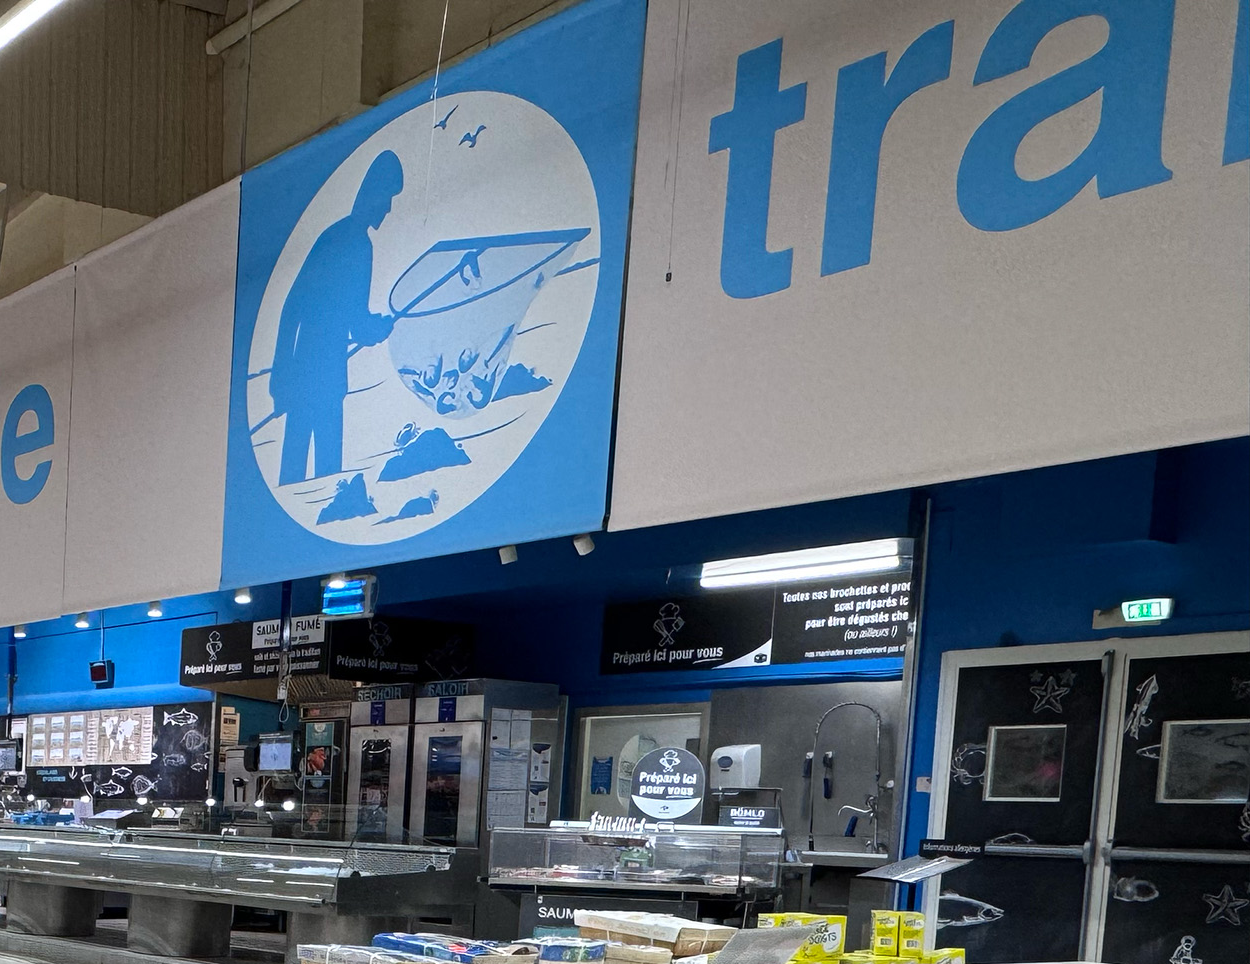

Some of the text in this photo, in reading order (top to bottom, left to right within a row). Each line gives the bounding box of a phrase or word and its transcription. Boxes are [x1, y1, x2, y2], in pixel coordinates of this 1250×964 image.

[783, 592, 810, 603] Toutes
[830, 584, 878, 599] brochettes
[880, 583, 889, 593] et
[856, 596, 898, 612] préparés
[295, 617, 321, 632] FUMÉ
[805, 618, 826, 630] pour
[848, 610, 889, 627] dégustés
[891, 610, 909, 622] che
[613, 647, 724, 665] Préparé ici pour vous
[639, 771, 697, 785] Préparé ici
[639, 785, 694, 796] pour vous
[538, 906, 575, 920] SAUM
